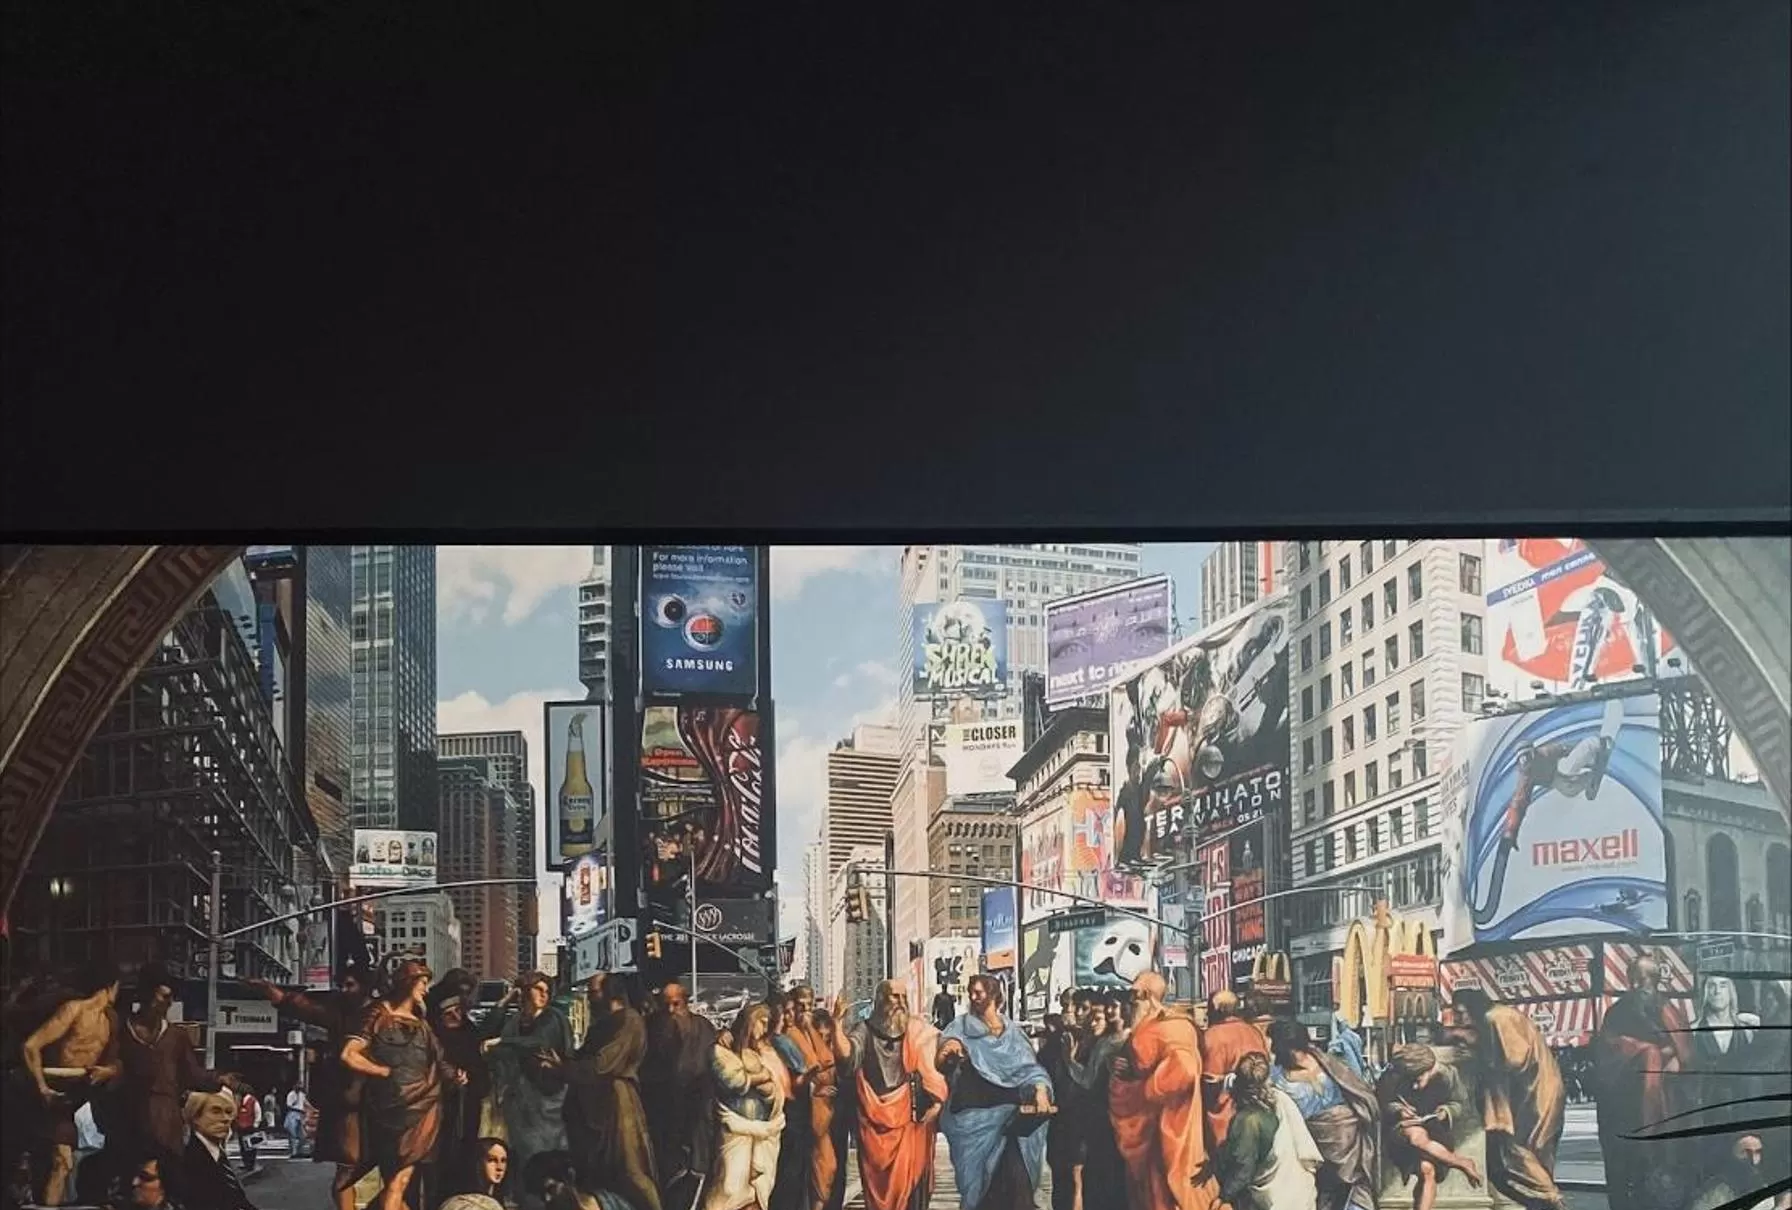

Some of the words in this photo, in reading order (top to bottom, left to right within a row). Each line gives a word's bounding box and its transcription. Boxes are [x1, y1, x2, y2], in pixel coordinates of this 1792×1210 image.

[666, 658, 734, 671] SAMSUNG
[1088, 664, 1106, 680] to
[971, 725, 1016, 741] CLOSER
[1533, 829, 1638, 866] maxell
